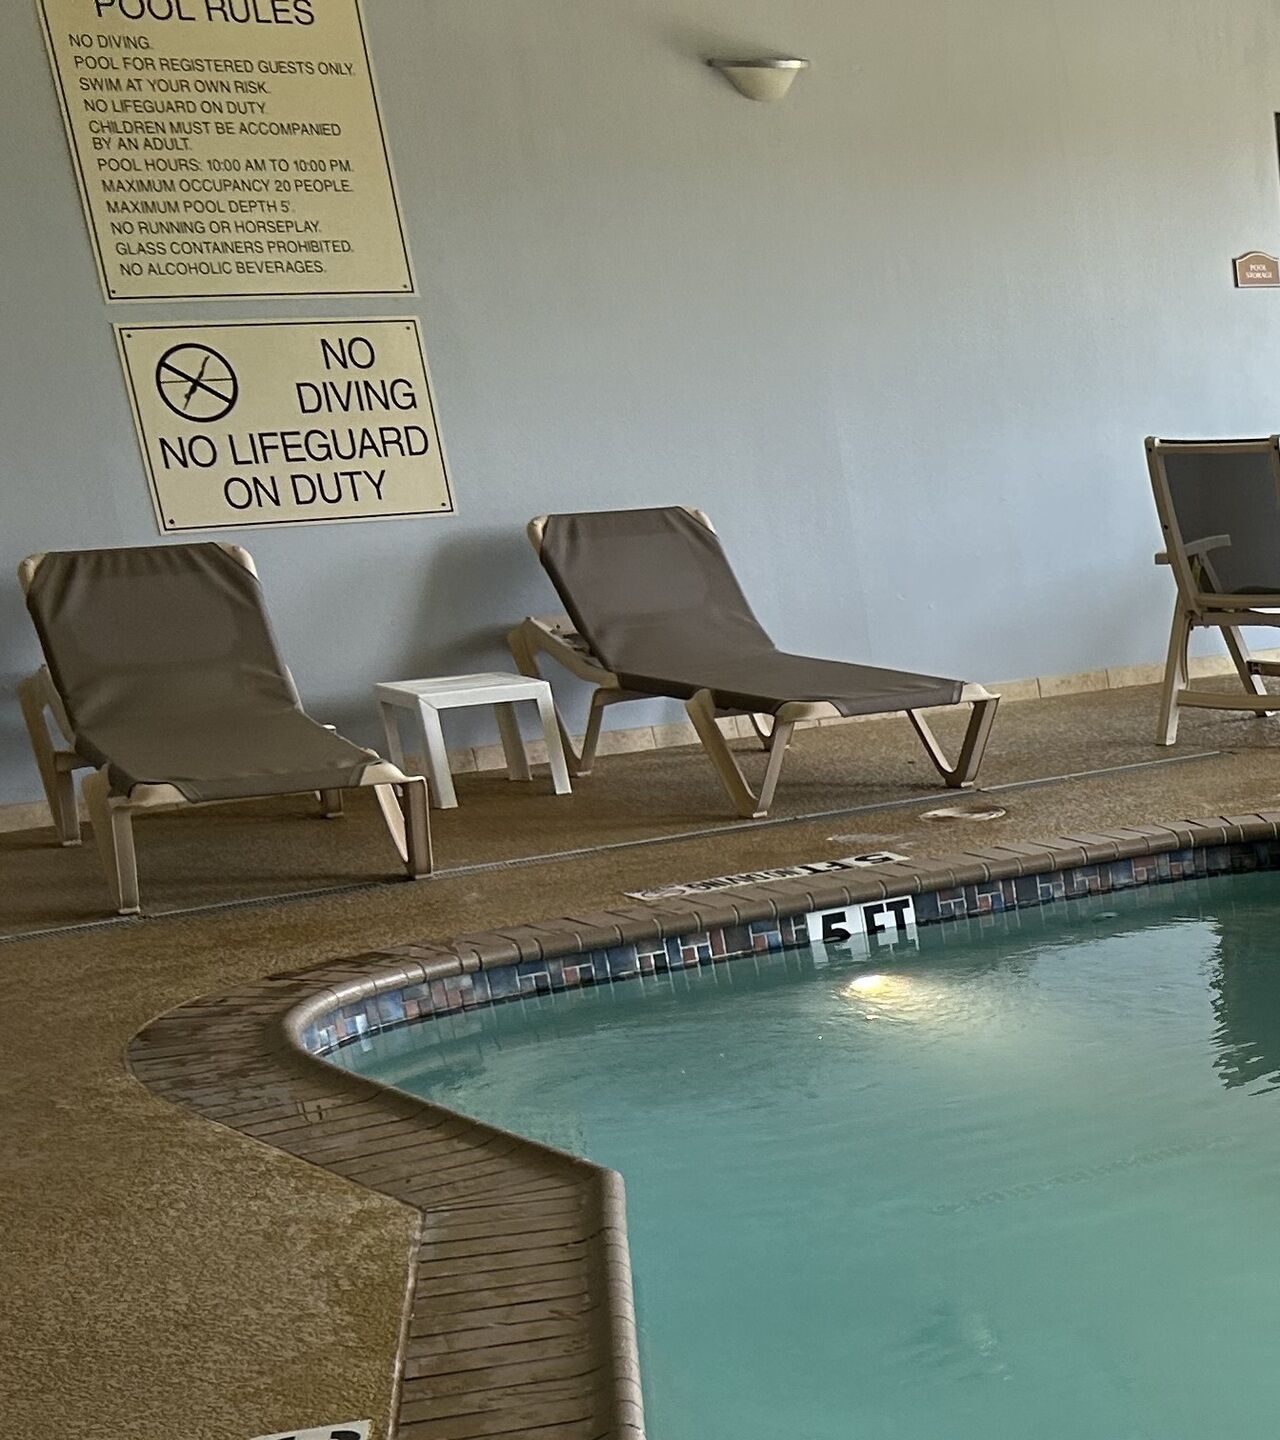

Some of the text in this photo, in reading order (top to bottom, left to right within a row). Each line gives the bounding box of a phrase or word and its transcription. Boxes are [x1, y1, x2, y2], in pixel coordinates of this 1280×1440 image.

[94, 0, 315, 25] POOL RULES
[68, 33, 93, 48] NO
[74, 56, 119, 70] POOL
[122, 57, 156, 71] FOR
[159, 58, 254, 74] REGISTERED
[258, 60, 315, 75] GUESTS
[79, 77, 122, 92] SWIM
[126, 79, 143, 91] AT
[146, 79, 191, 93] YOUR
[194, 79, 231, 93] OWN
[84, 99, 108, 112] NO
[112, 100, 197, 114] LIFEGUARD
[201, 101, 223, 114] ON
[89, 120, 342, 136] CHILDREN MUST BE ACCOMPANIED
[92, 137, 111, 150] BY
[118, 138, 139, 150] AN
[97, 158, 142, 171] POOL
[144, 159, 202, 172] HOURS:
[207, 159, 241, 172] 10:00
[245, 159, 266, 171] AM
[269, 159, 289, 172] TO
[293, 160, 326, 172] 10:00
[102, 179, 176, 192] MAXIMUM
[179, 179, 270, 193] OCCUPANCY
[274, 180, 291, 192] 20
[106, 200, 180, 214] MAXIMUM
[183, 200, 225, 213] POOL
[228, 200, 277, 213] DEPTH
[110, 221, 134, 234] NO
[138, 221, 205, 234] RUNNING
[209, 221, 231, 233] OR
[116, 242, 167, 255] GLASS
[170, 241, 264, 255] CONTAINERS
[119, 263, 143, 276] NO
[148, 262, 232, 275] ALCOHOLIC
[320, 336, 375, 370] NO
[296, 378, 418, 414] DIVING
[158, 425, 429, 469] NO LIFEGUARD
[223, 469, 386, 510] ON DUTY
[854, 853, 894, 865] 5
[821, 911, 852, 944] 5
